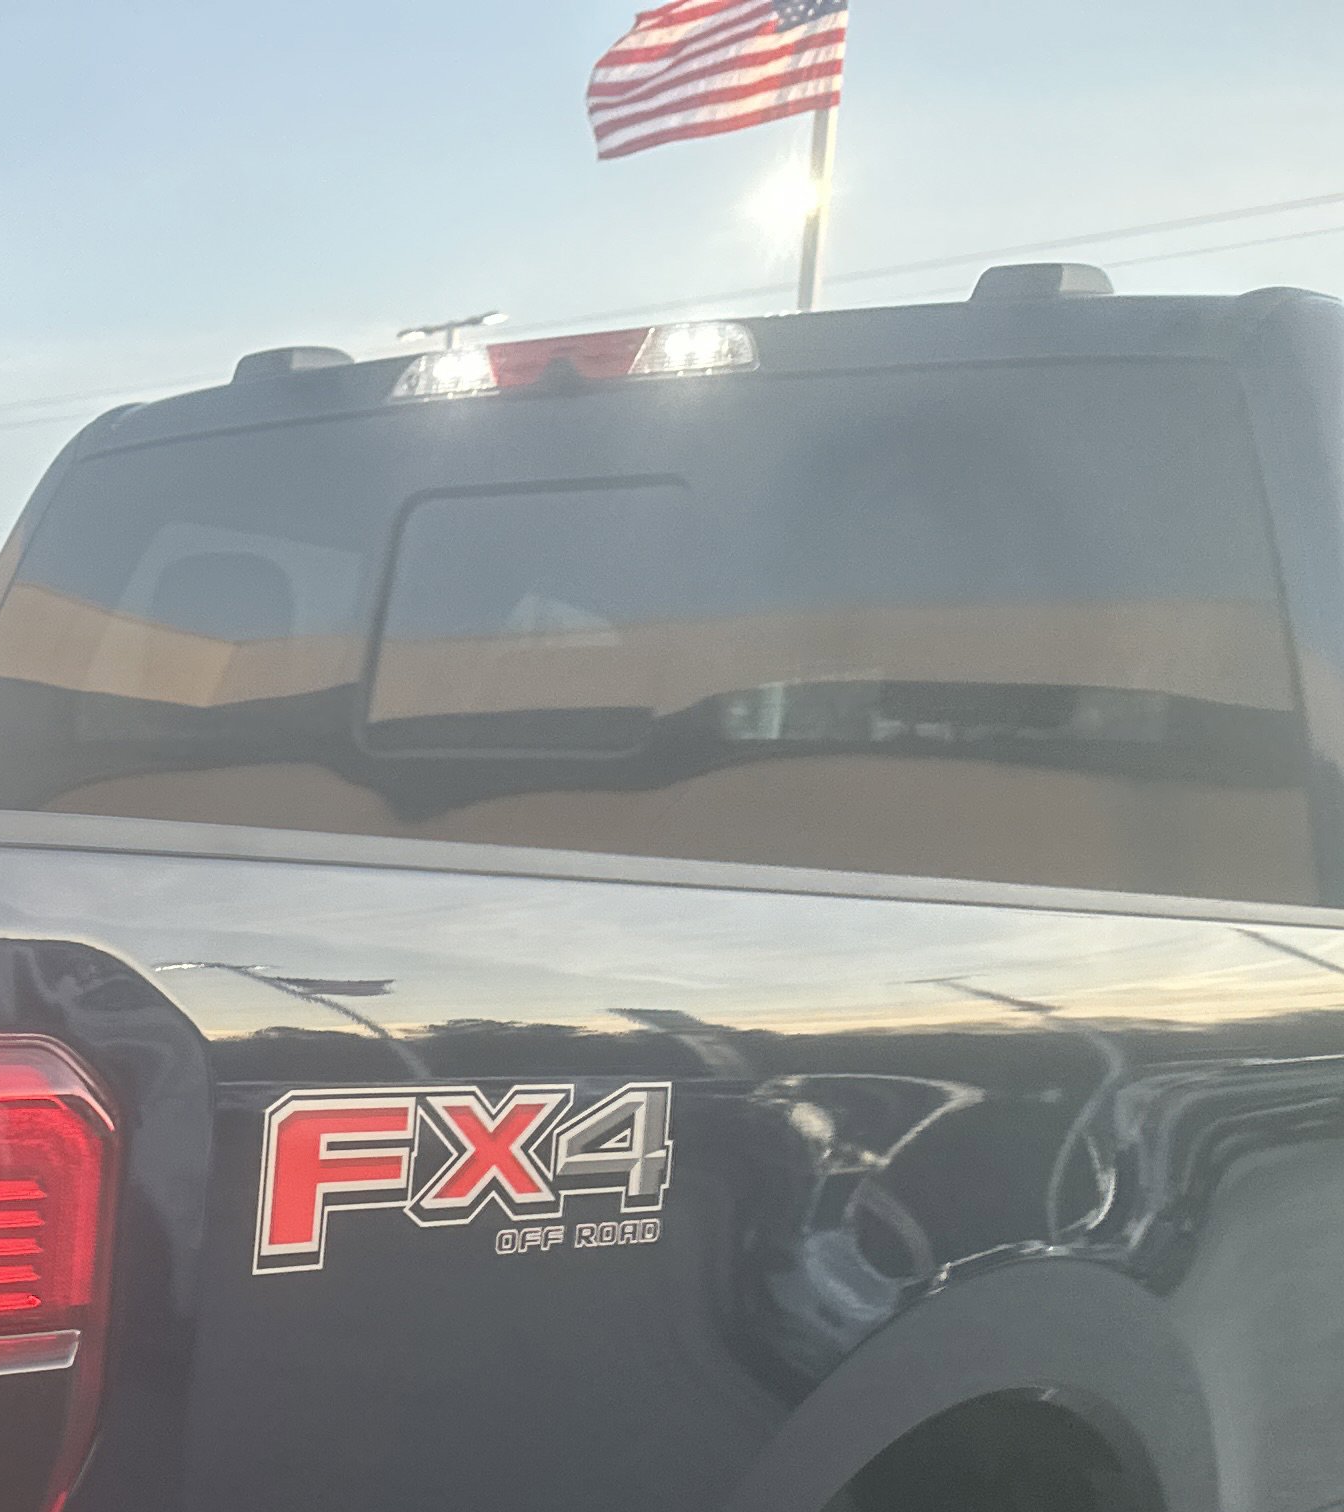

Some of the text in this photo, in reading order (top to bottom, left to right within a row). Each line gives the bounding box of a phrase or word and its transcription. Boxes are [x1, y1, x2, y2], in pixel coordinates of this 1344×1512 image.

[253, 1082, 673, 1275] FX4
[495, 1218, 661, 1254] OFF ROAD
